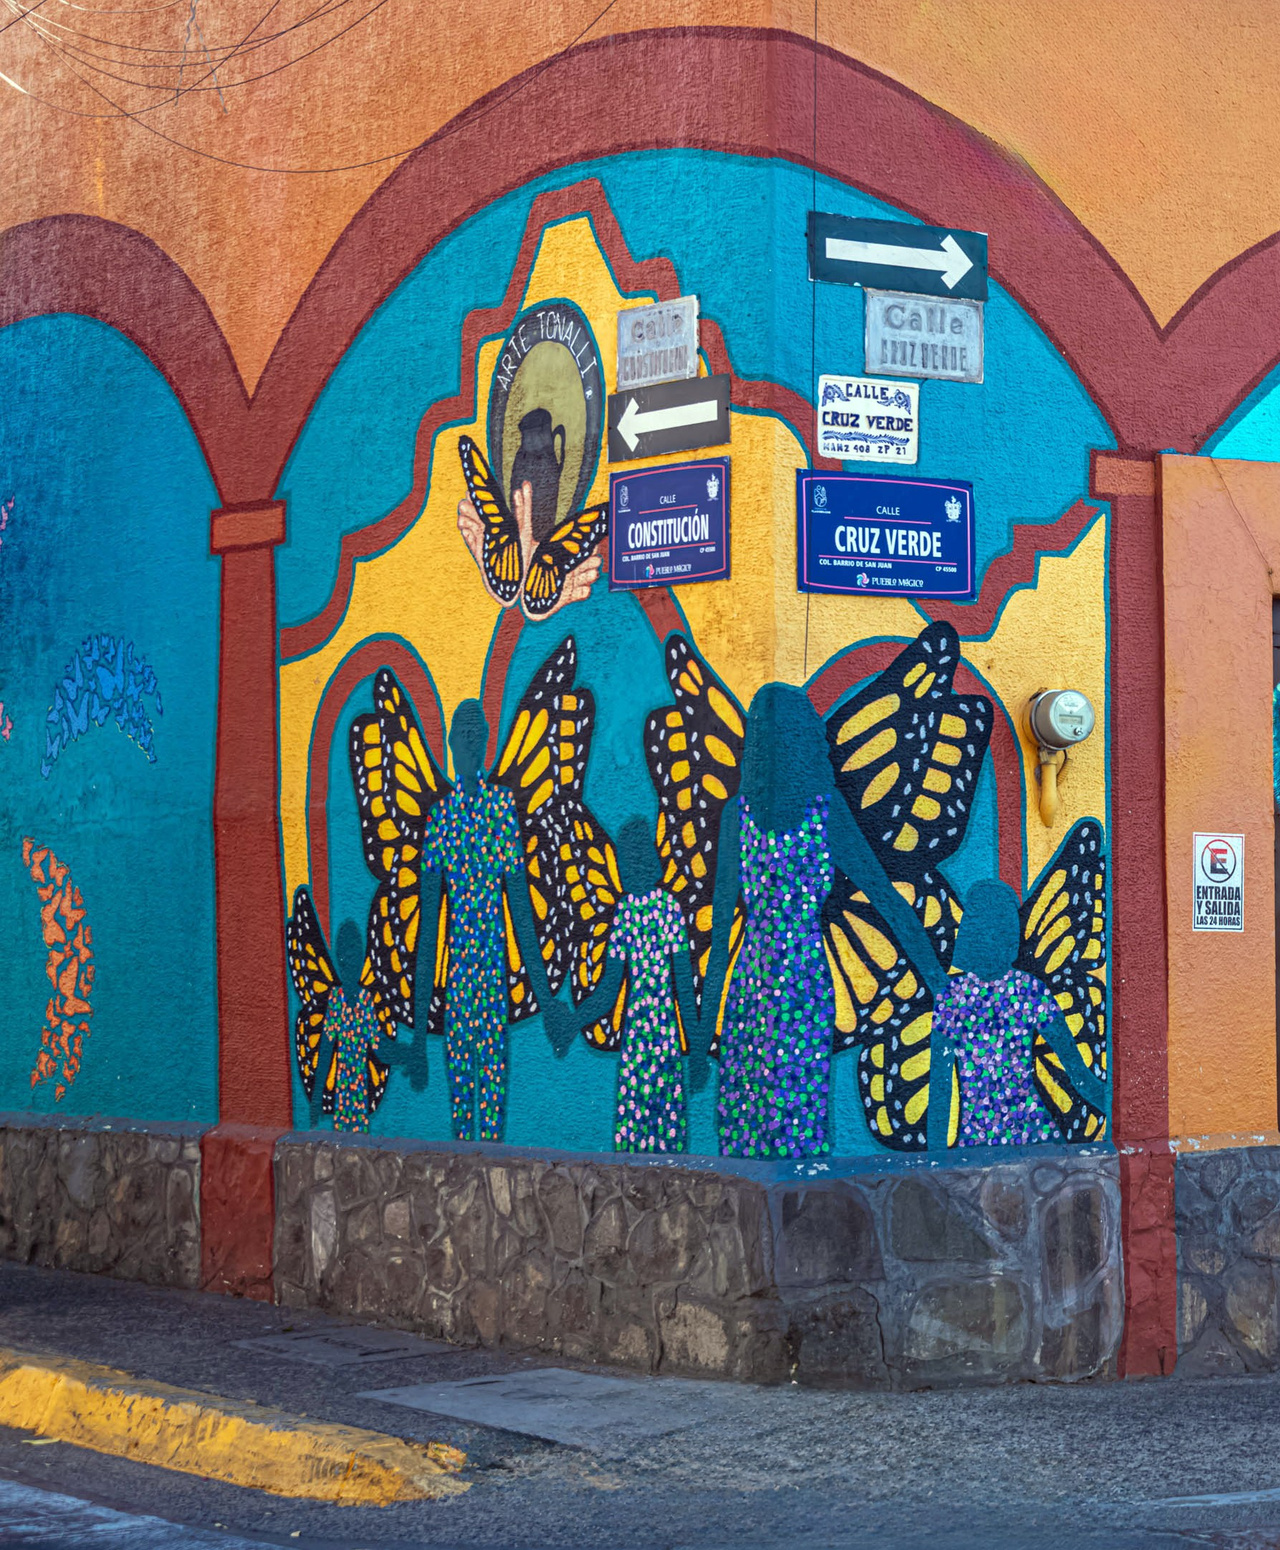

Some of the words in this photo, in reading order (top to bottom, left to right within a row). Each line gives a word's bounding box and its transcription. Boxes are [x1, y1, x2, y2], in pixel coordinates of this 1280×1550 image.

[885, 304, 963, 335] Calle
[497, 324, 532, 391] ARTE
[536, 311, 598, 379] TONALLI
[881, 339, 917, 368] CRUZ
[921, 342, 969, 372] VERDE
[845, 383, 889, 400] CALLE
[822, 411, 860, 428] CRUZ
[866, 415, 914, 432] VERDE
[896, 447, 907, 456] 21
[659, 494, 677, 505] CALLE
[876, 506, 900, 516] CALLE
[627, 508, 710, 549] CONSTITUCIÓN
[834, 525, 880, 554] CRUZ
[885, 528, 942, 558] VERDE
[819, 558, 832, 566] COL.
[833, 559, 855, 567] BARRIO
[856, 560, 864, 568] DE
[865, 561, 876, 569] SAN
[872, 577, 897, 586] PUEBLO
[1196, 885, 1241, 900] ENTRADA
[1197, 900, 1203, 915] Y
[1205, 901, 1241, 915] SALIDA
[1196, 916, 1208, 925] LAS
[1209, 916, 1218, 926] 24
[1219, 917, 1241, 926] HORAS
